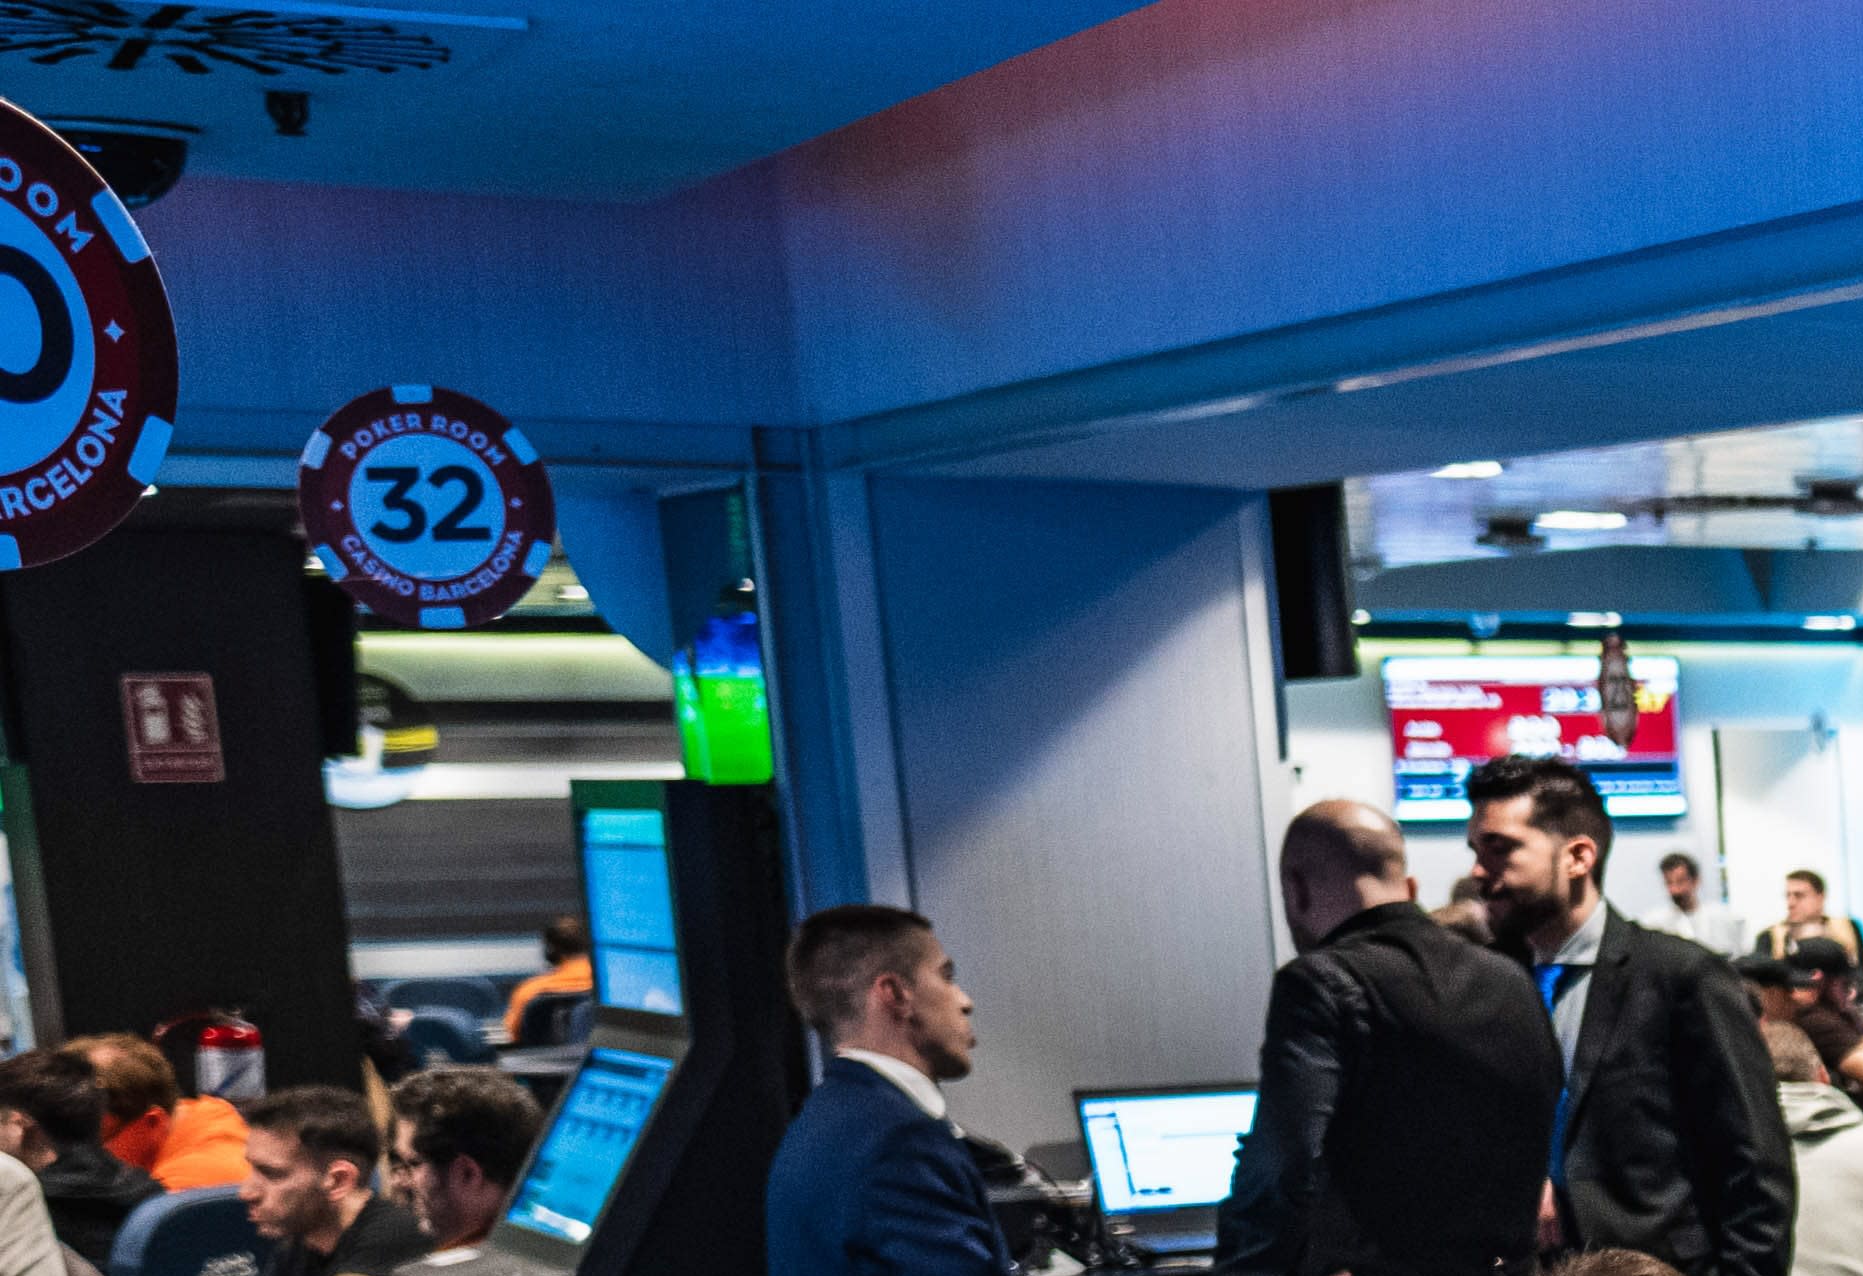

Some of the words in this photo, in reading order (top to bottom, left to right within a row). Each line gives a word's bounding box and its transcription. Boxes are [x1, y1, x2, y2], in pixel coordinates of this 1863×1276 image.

[0, 156, 95, 254] OOM
[0, 387, 129, 521] RCELONA
[340, 412, 423, 459] POKER
[430, 414, 508, 465] ROOM
[365, 465, 492, 543] 32
[341, 534, 416, 596] CASINO
[418, 530, 523, 601] BARCELONA
